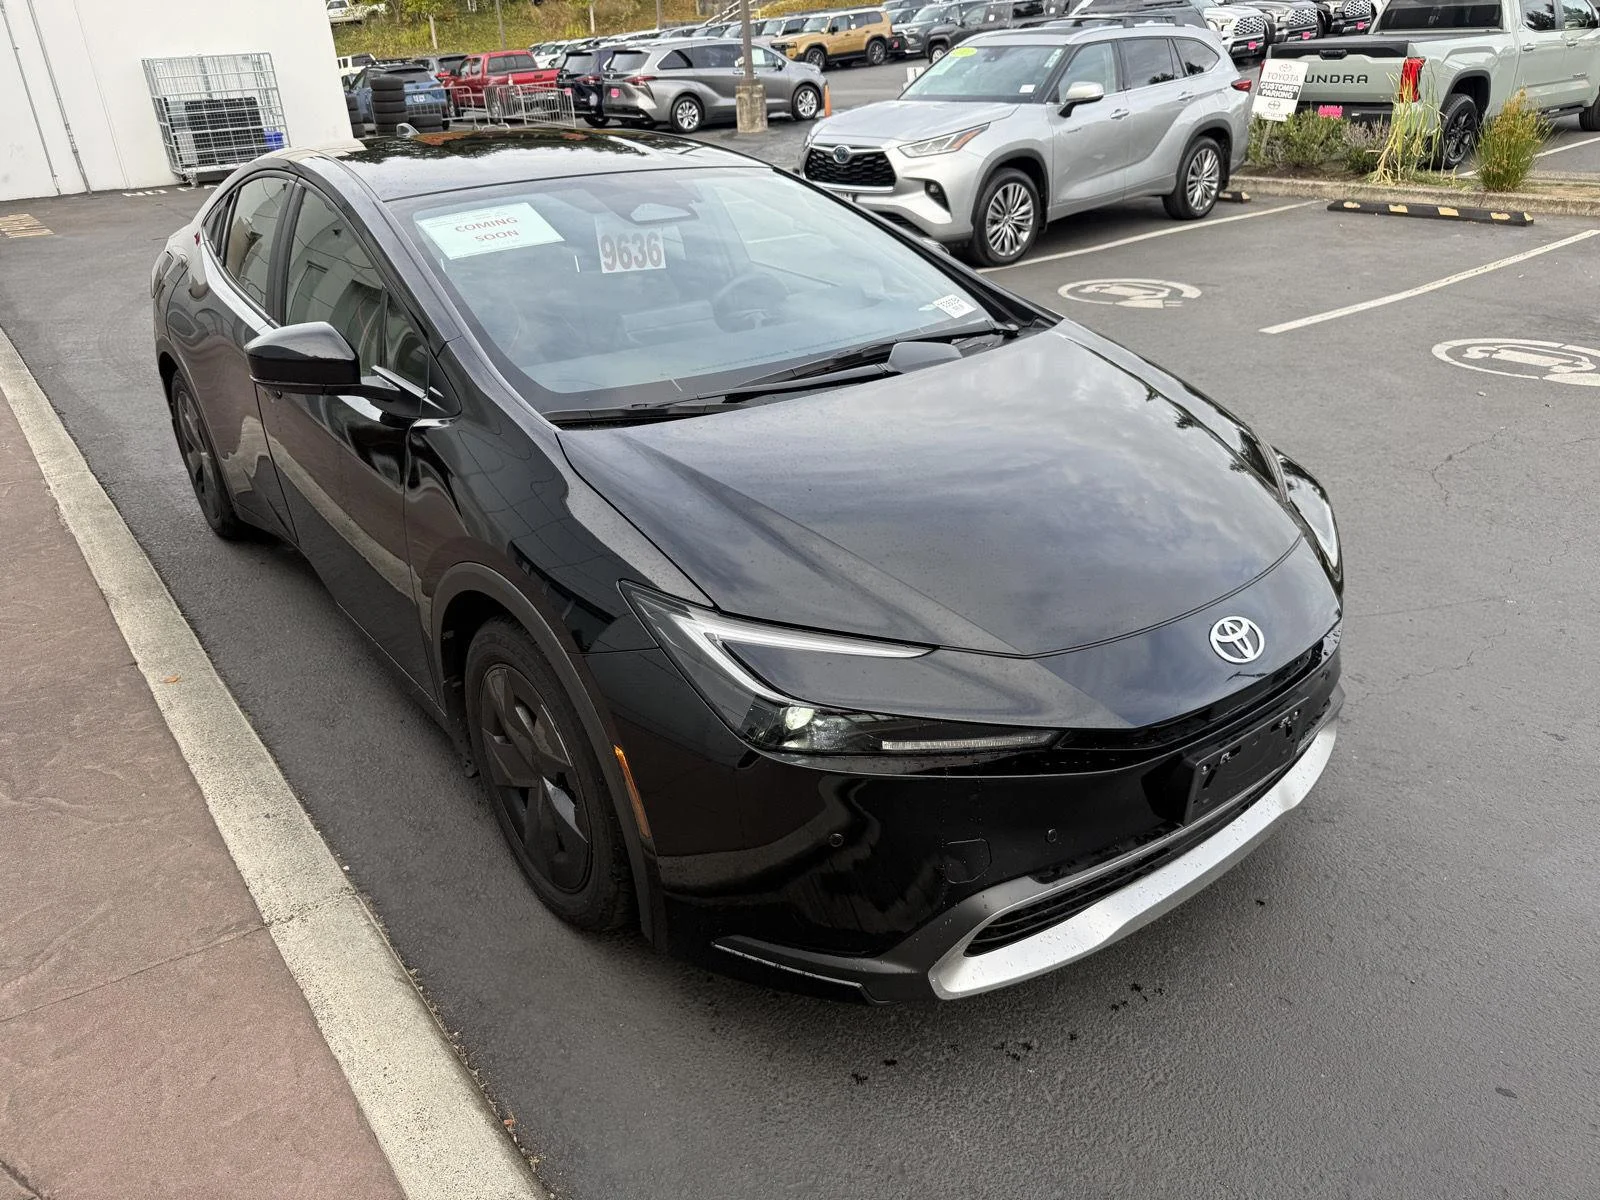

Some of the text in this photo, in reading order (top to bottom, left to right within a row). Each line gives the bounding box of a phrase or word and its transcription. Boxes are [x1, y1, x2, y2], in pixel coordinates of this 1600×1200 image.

[1267, 71, 1299, 82] TOYOTA
[1303, 74, 1369, 84] UNDRA
[1260, 82, 1300, 93] CUSTOMER
[1261, 89, 1294, 99] PARKING
[455, 215, 519, 232] COMING
[474, 229, 520, 242] SOON
[600, 231, 663, 271] 9636
